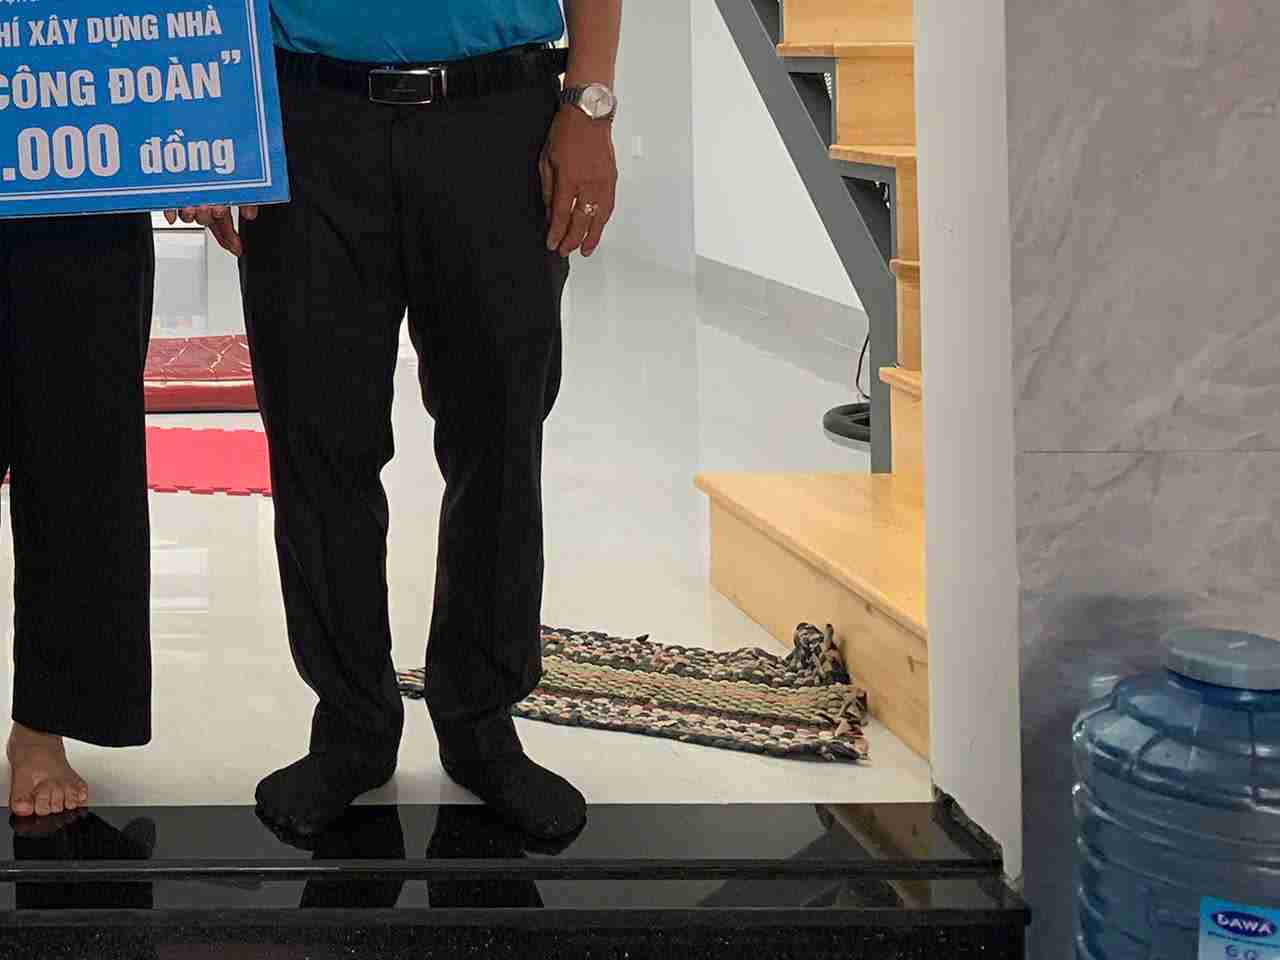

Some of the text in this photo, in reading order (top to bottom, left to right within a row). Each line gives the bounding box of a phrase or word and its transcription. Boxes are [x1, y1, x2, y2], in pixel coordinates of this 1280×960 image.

[28, 15, 79, 47] XÂY
[86, 13, 160, 49] DỰNG
[166, 4, 222, 39] NHÀ
[139, 128, 236, 175] đồng
[1217, 913, 1272, 933] DAWA
